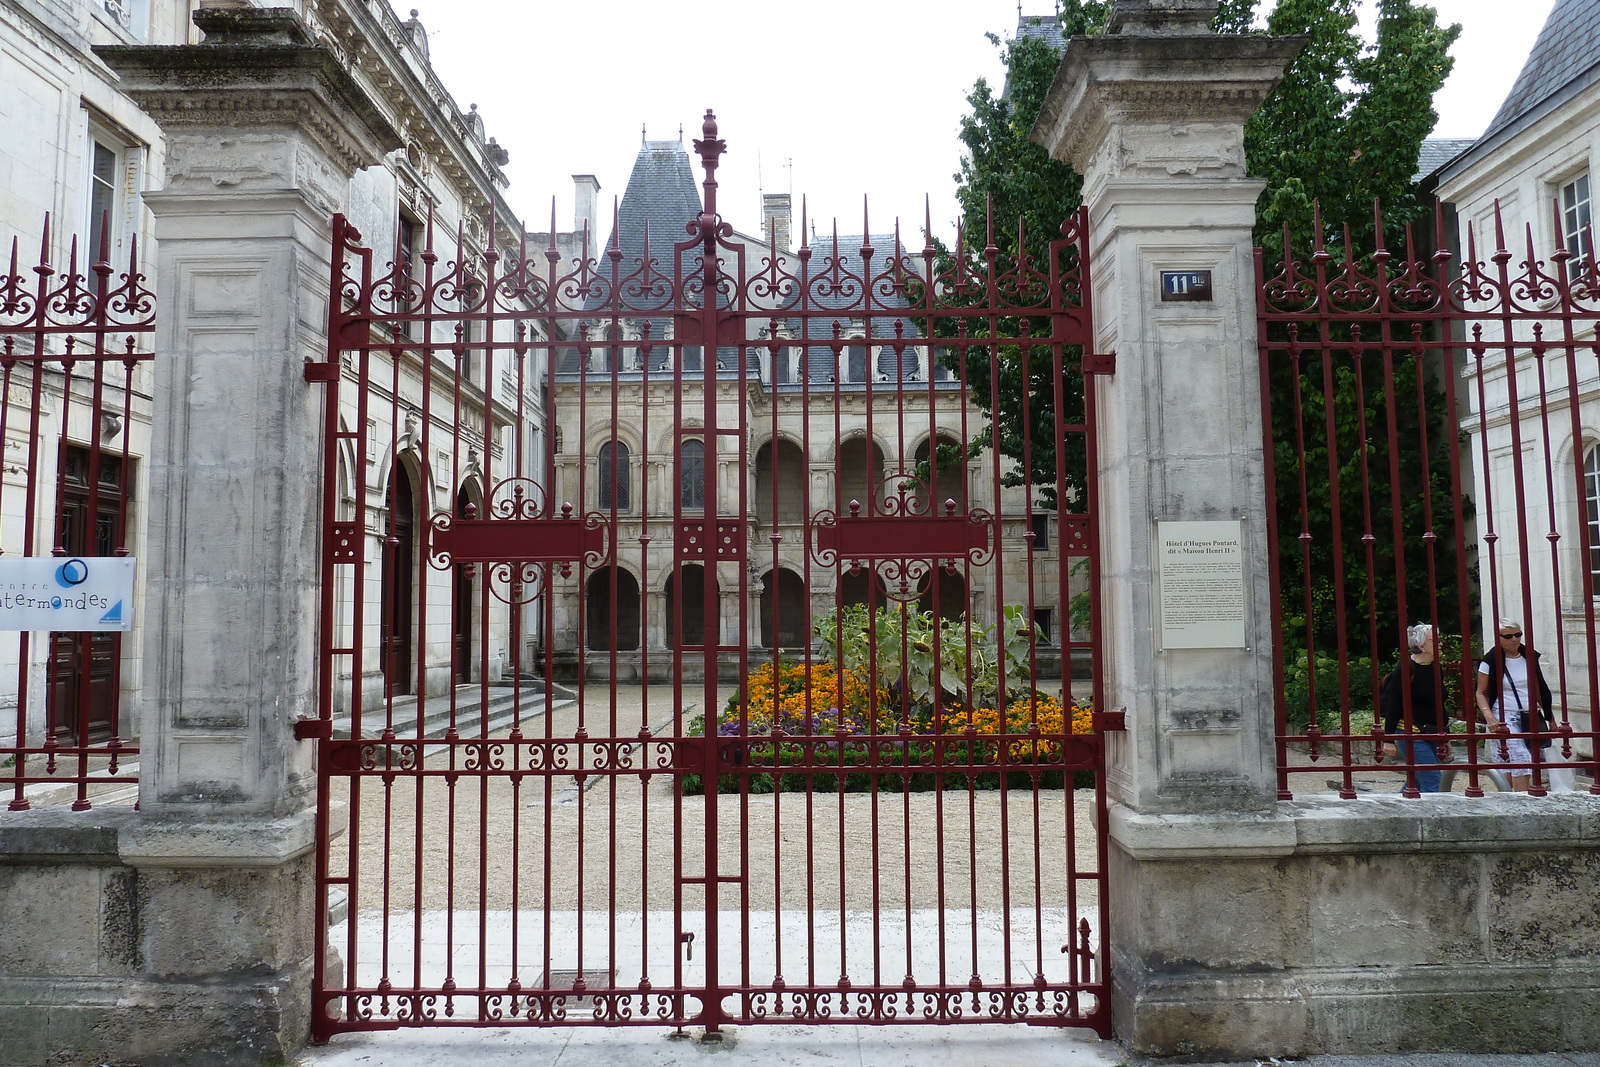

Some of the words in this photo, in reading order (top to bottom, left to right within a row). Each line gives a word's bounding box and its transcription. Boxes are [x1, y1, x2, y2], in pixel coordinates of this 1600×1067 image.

[1171, 276, 1189, 294] 11
[1192, 275, 1205, 284] BIS
[0, 592, 108, 610] termondes
